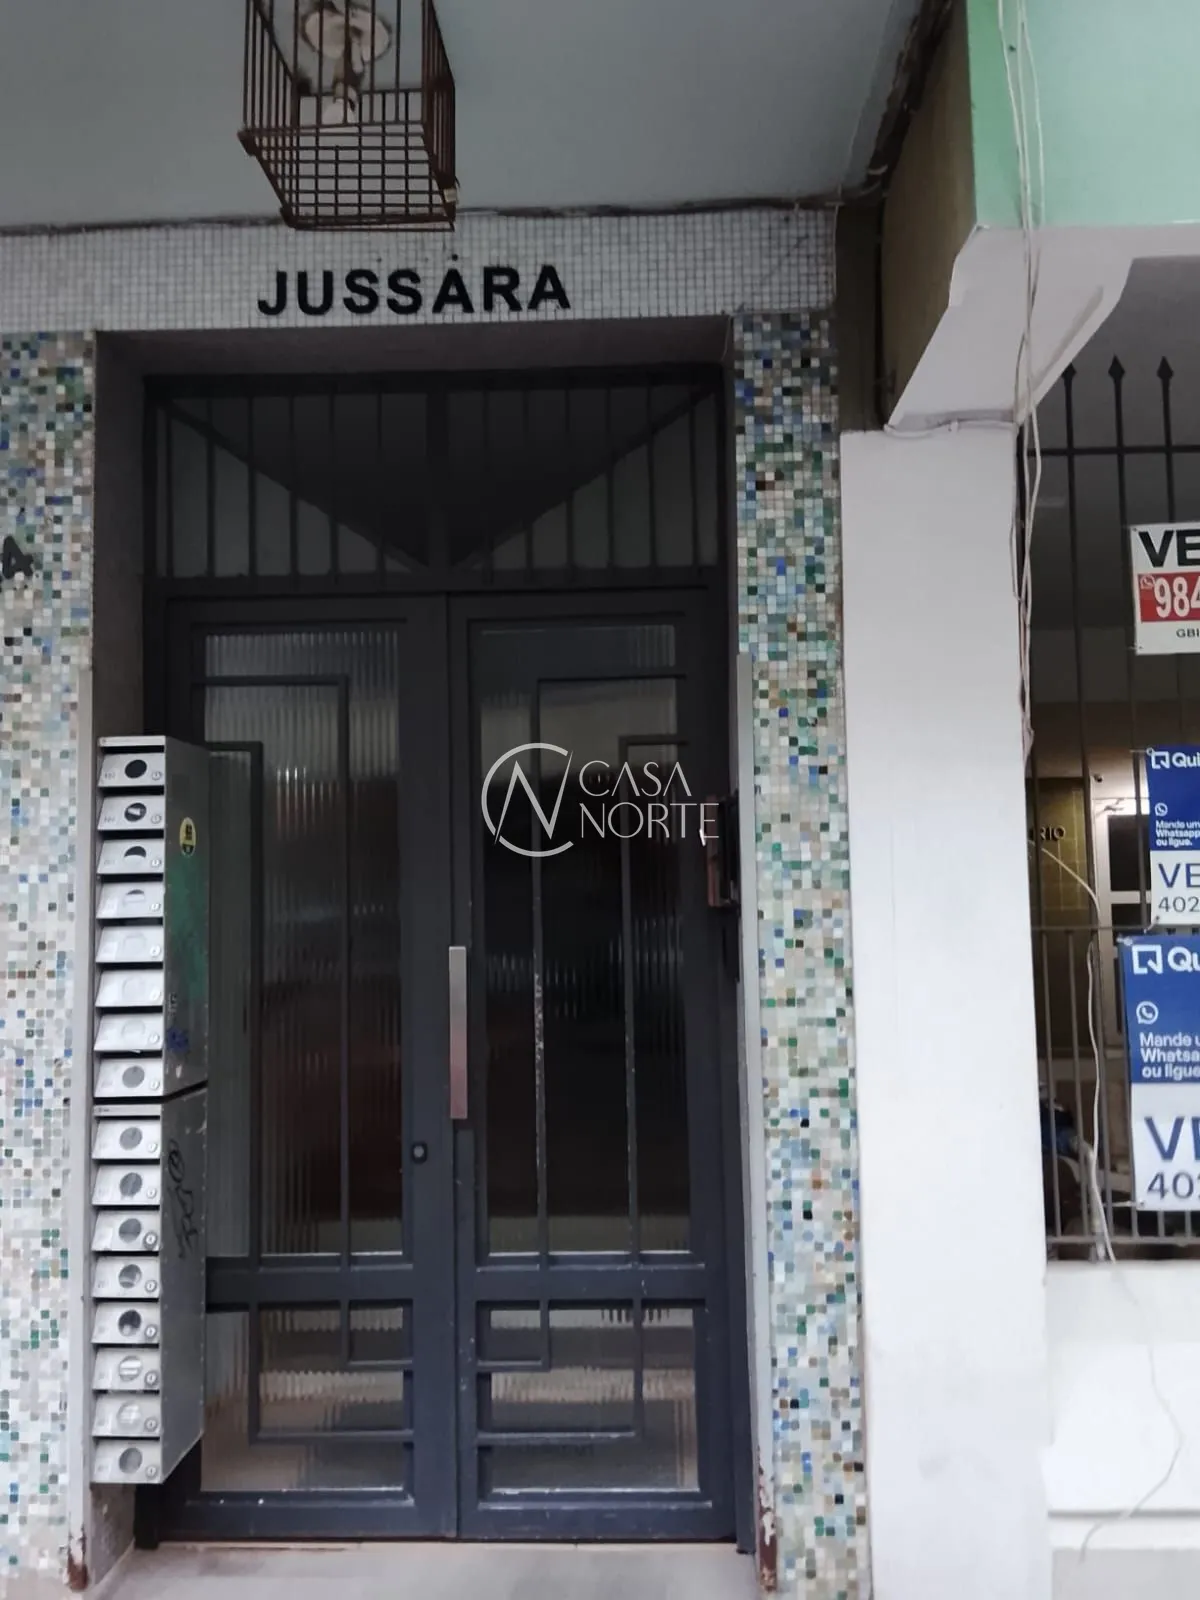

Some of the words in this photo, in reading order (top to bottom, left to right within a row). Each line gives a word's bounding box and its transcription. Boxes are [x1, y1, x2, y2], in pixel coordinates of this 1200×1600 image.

[257, 264, 571, 316] JUSSARA
[1158, 896, 1200, 913] 402
[1139, 1032, 1192, 1047] Mande
[1142, 1066, 1162, 1078] ou
[1147, 1171, 1200, 1199] 40
